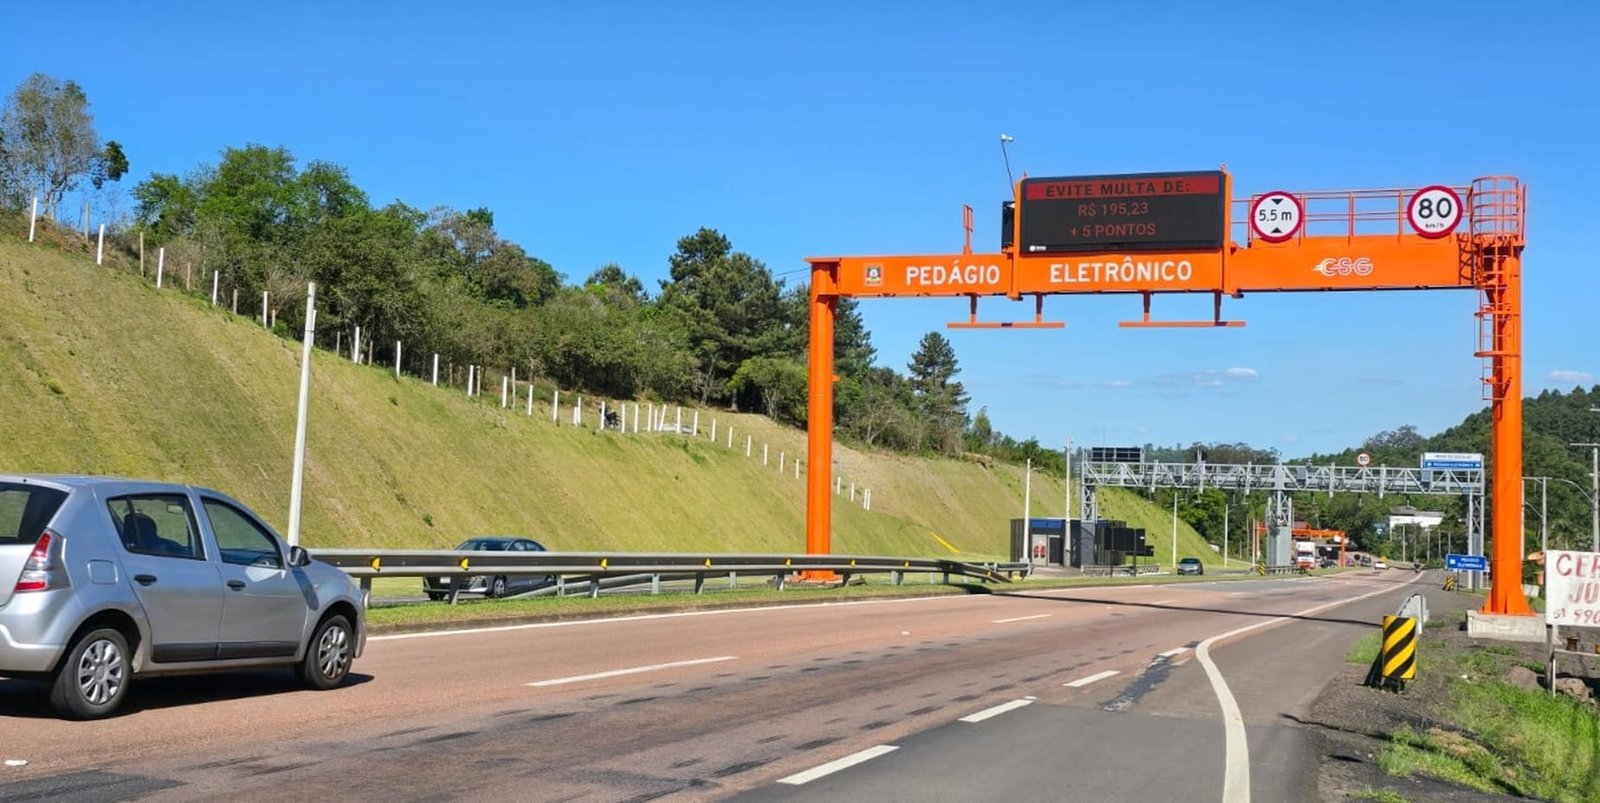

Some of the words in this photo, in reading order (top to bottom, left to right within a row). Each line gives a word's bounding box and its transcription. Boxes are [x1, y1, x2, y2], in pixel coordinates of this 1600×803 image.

[1046, 184, 1093, 197] EVITE
[1100, 182, 1156, 195] MULTA
[1163, 181, 1191, 193] DE:
[1078, 203, 1096, 217] R$
[1101, 202, 1149, 217] 195,23
[1281, 211, 1292, 221] m
[1419, 197, 1452, 219] 80
[1083, 225, 1091, 237] 5
[1095, 222, 1156, 237] PONTOS
[906, 259, 1000, 285] PEDÁGIO
[1050, 256, 1192, 283] ELETRÔNICO
[1317, 258, 1373, 276] CSG
